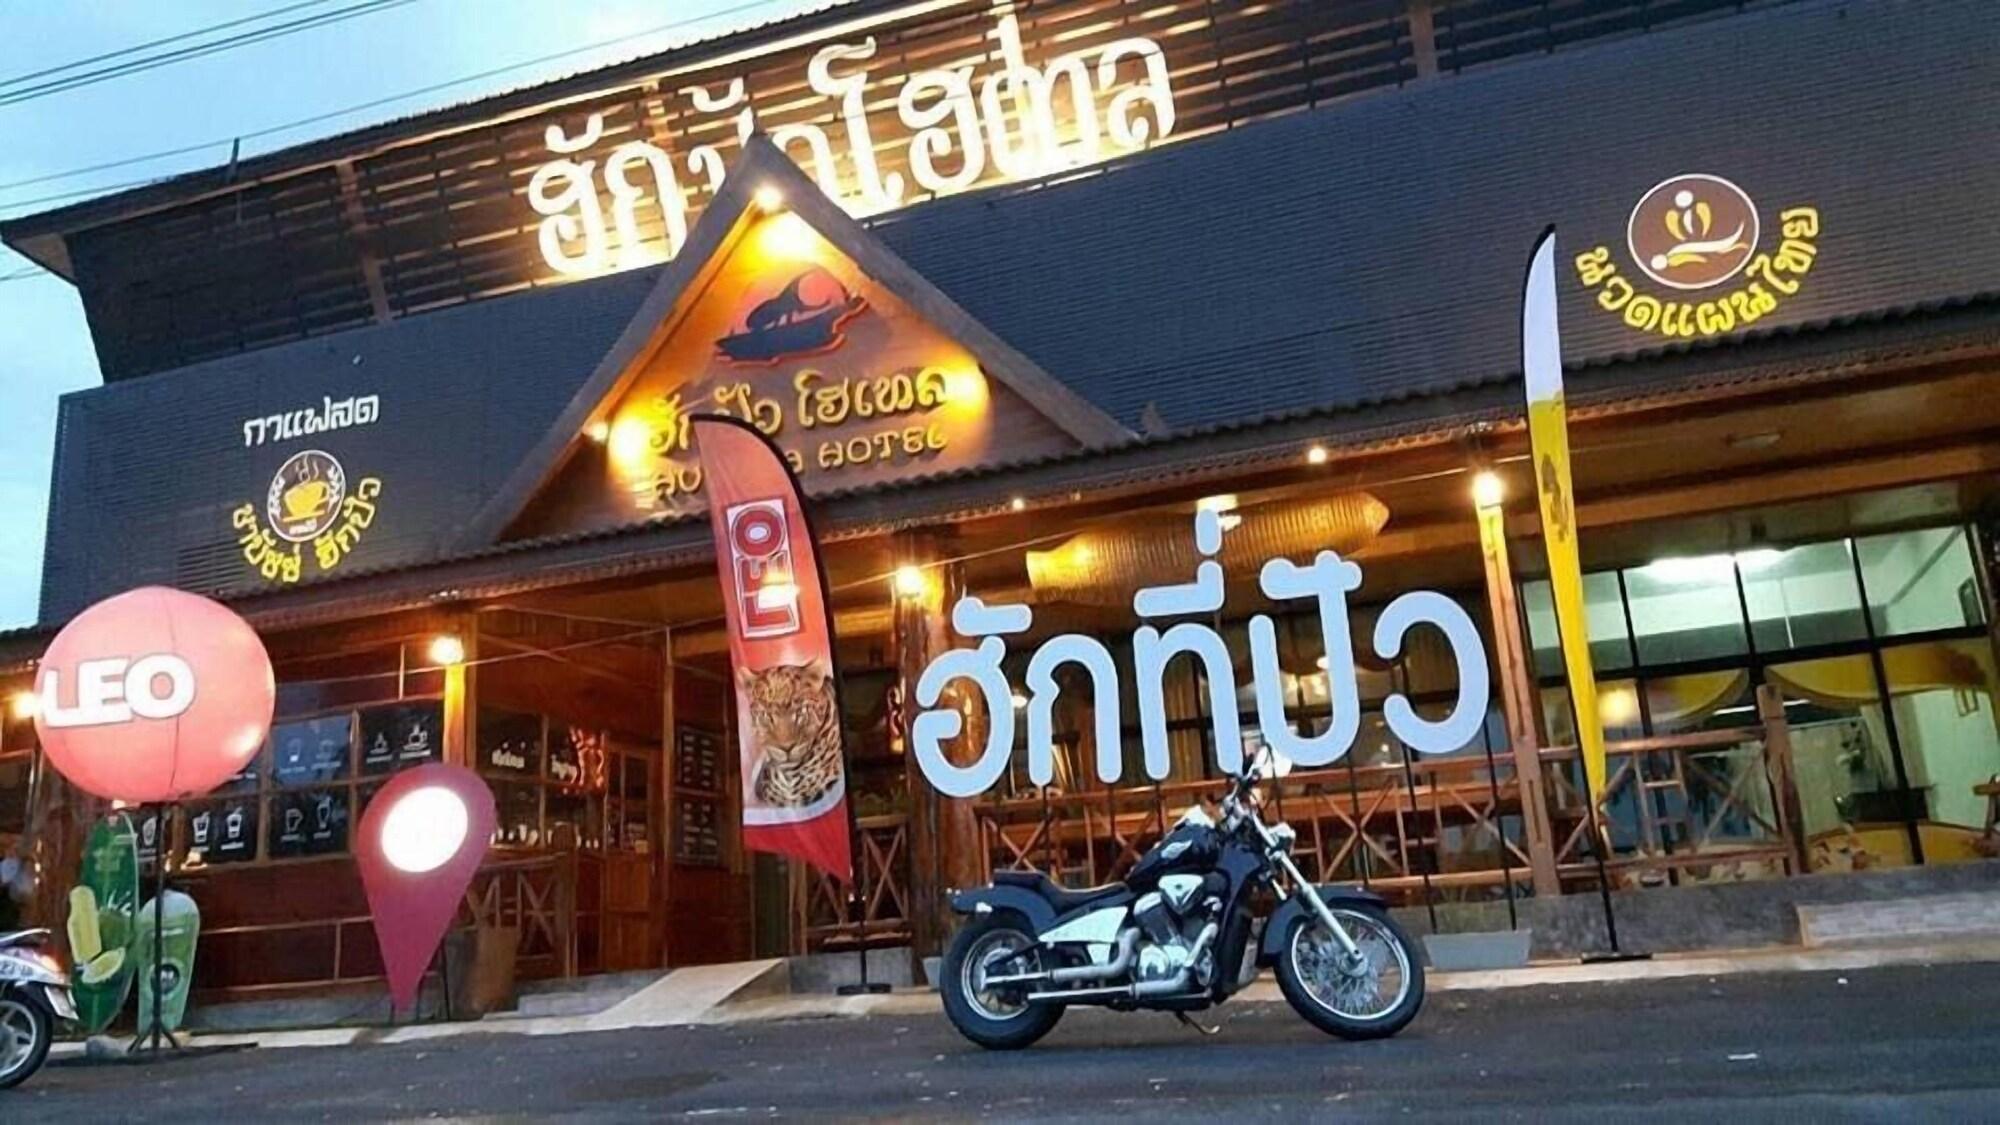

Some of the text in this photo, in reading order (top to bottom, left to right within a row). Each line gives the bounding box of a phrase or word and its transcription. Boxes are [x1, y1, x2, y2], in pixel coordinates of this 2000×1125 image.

[1575, 206, 1820, 338] นวดแผนไทย
[243, 394, 380, 448] กาแฟสด
[729, 503, 797, 633] LEO
[42, 652, 197, 728] LEO
[911, 508, 1491, 798] ฮักที่ปัว
